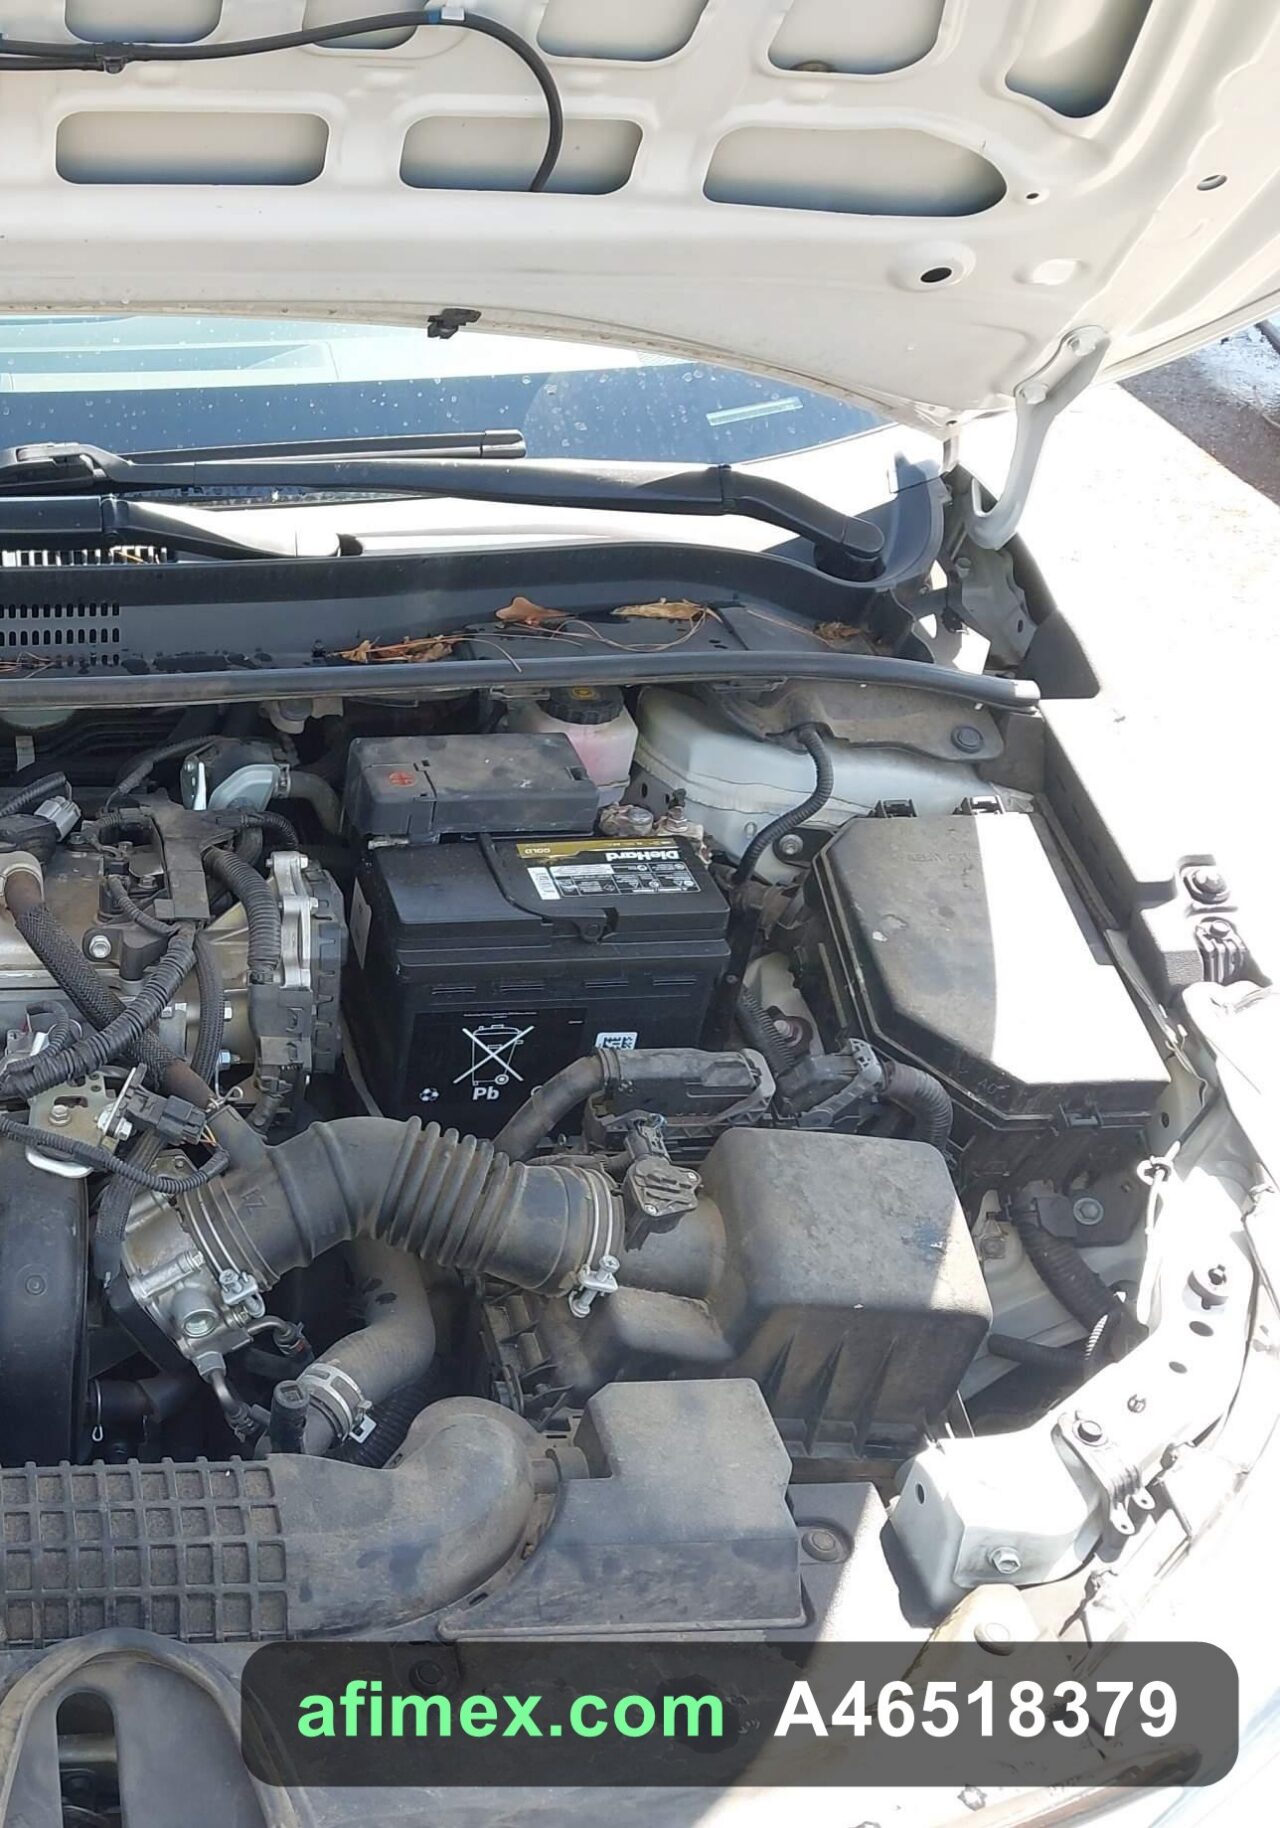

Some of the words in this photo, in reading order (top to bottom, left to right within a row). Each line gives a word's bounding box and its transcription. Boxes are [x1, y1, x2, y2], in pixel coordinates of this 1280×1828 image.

[524, 847, 551, 855] GOLD
[605, 850, 680, 862] DieHard
[472, 1086, 500, 1100] Pb
